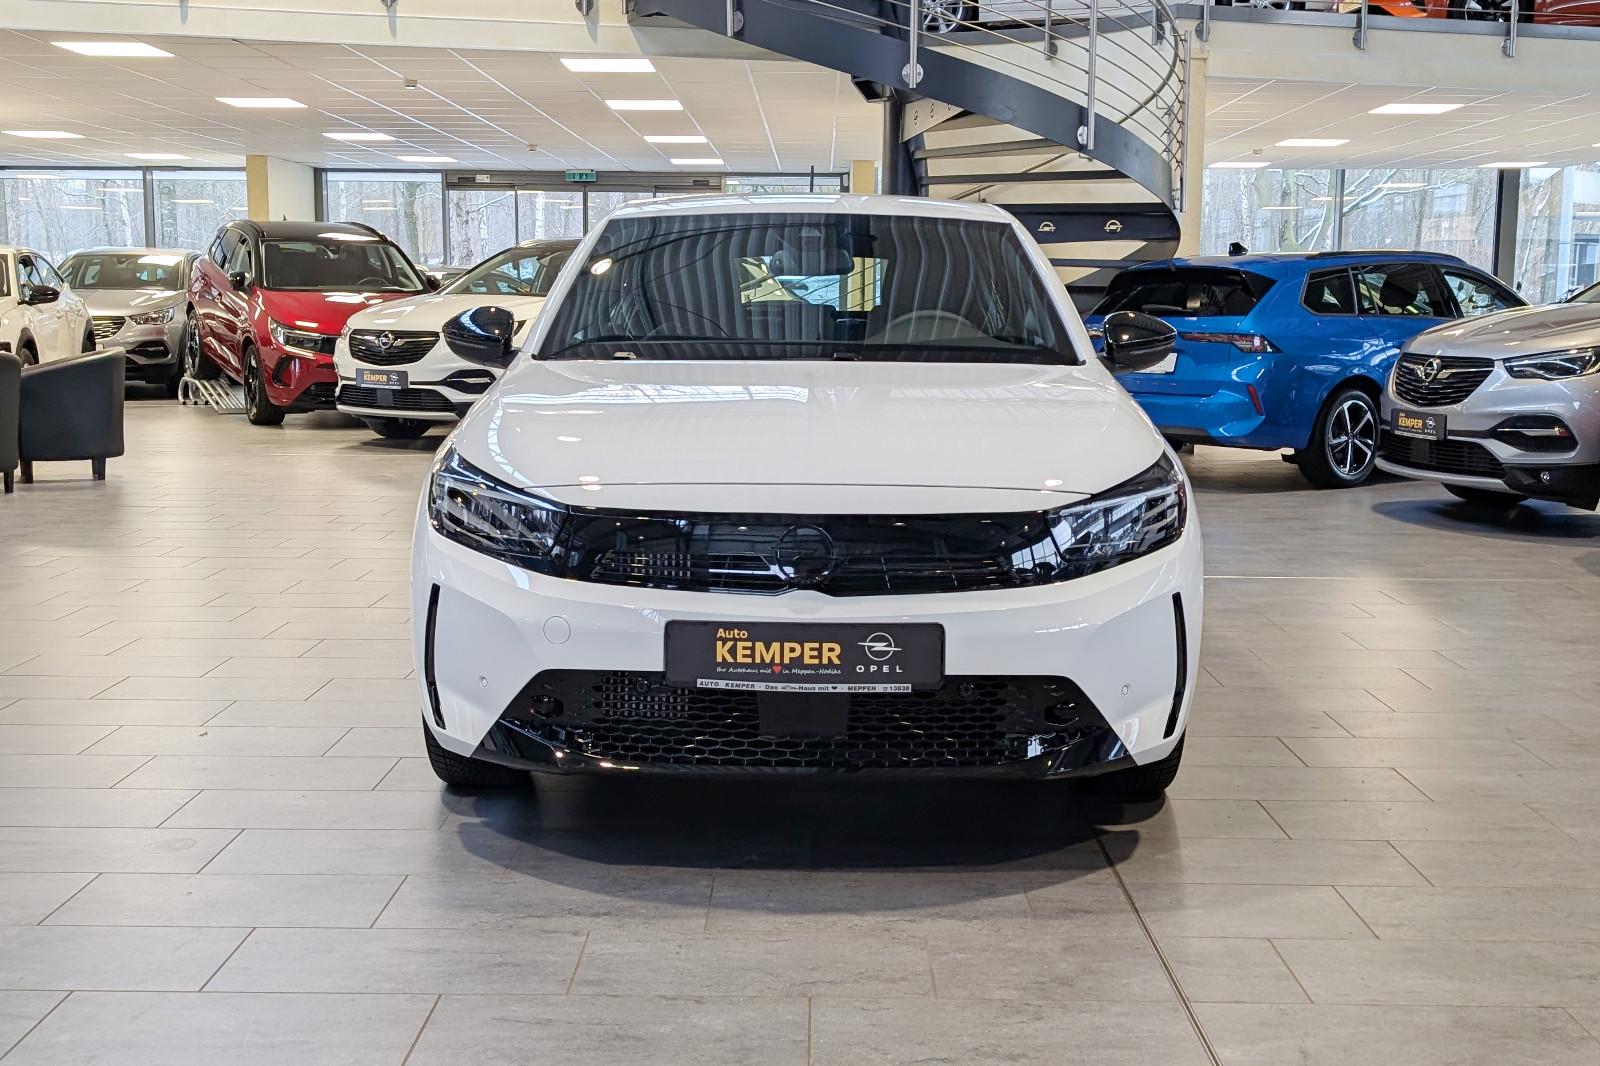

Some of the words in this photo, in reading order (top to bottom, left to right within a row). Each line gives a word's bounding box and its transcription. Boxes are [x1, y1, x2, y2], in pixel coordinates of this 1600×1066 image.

[364, 373, 388, 382] KEMPER
[1398, 416, 1422, 428] KEMPER
[716, 628, 748, 639] Auto
[716, 641, 841, 665] KEMPER
[856, 665, 903, 673] OPEL
